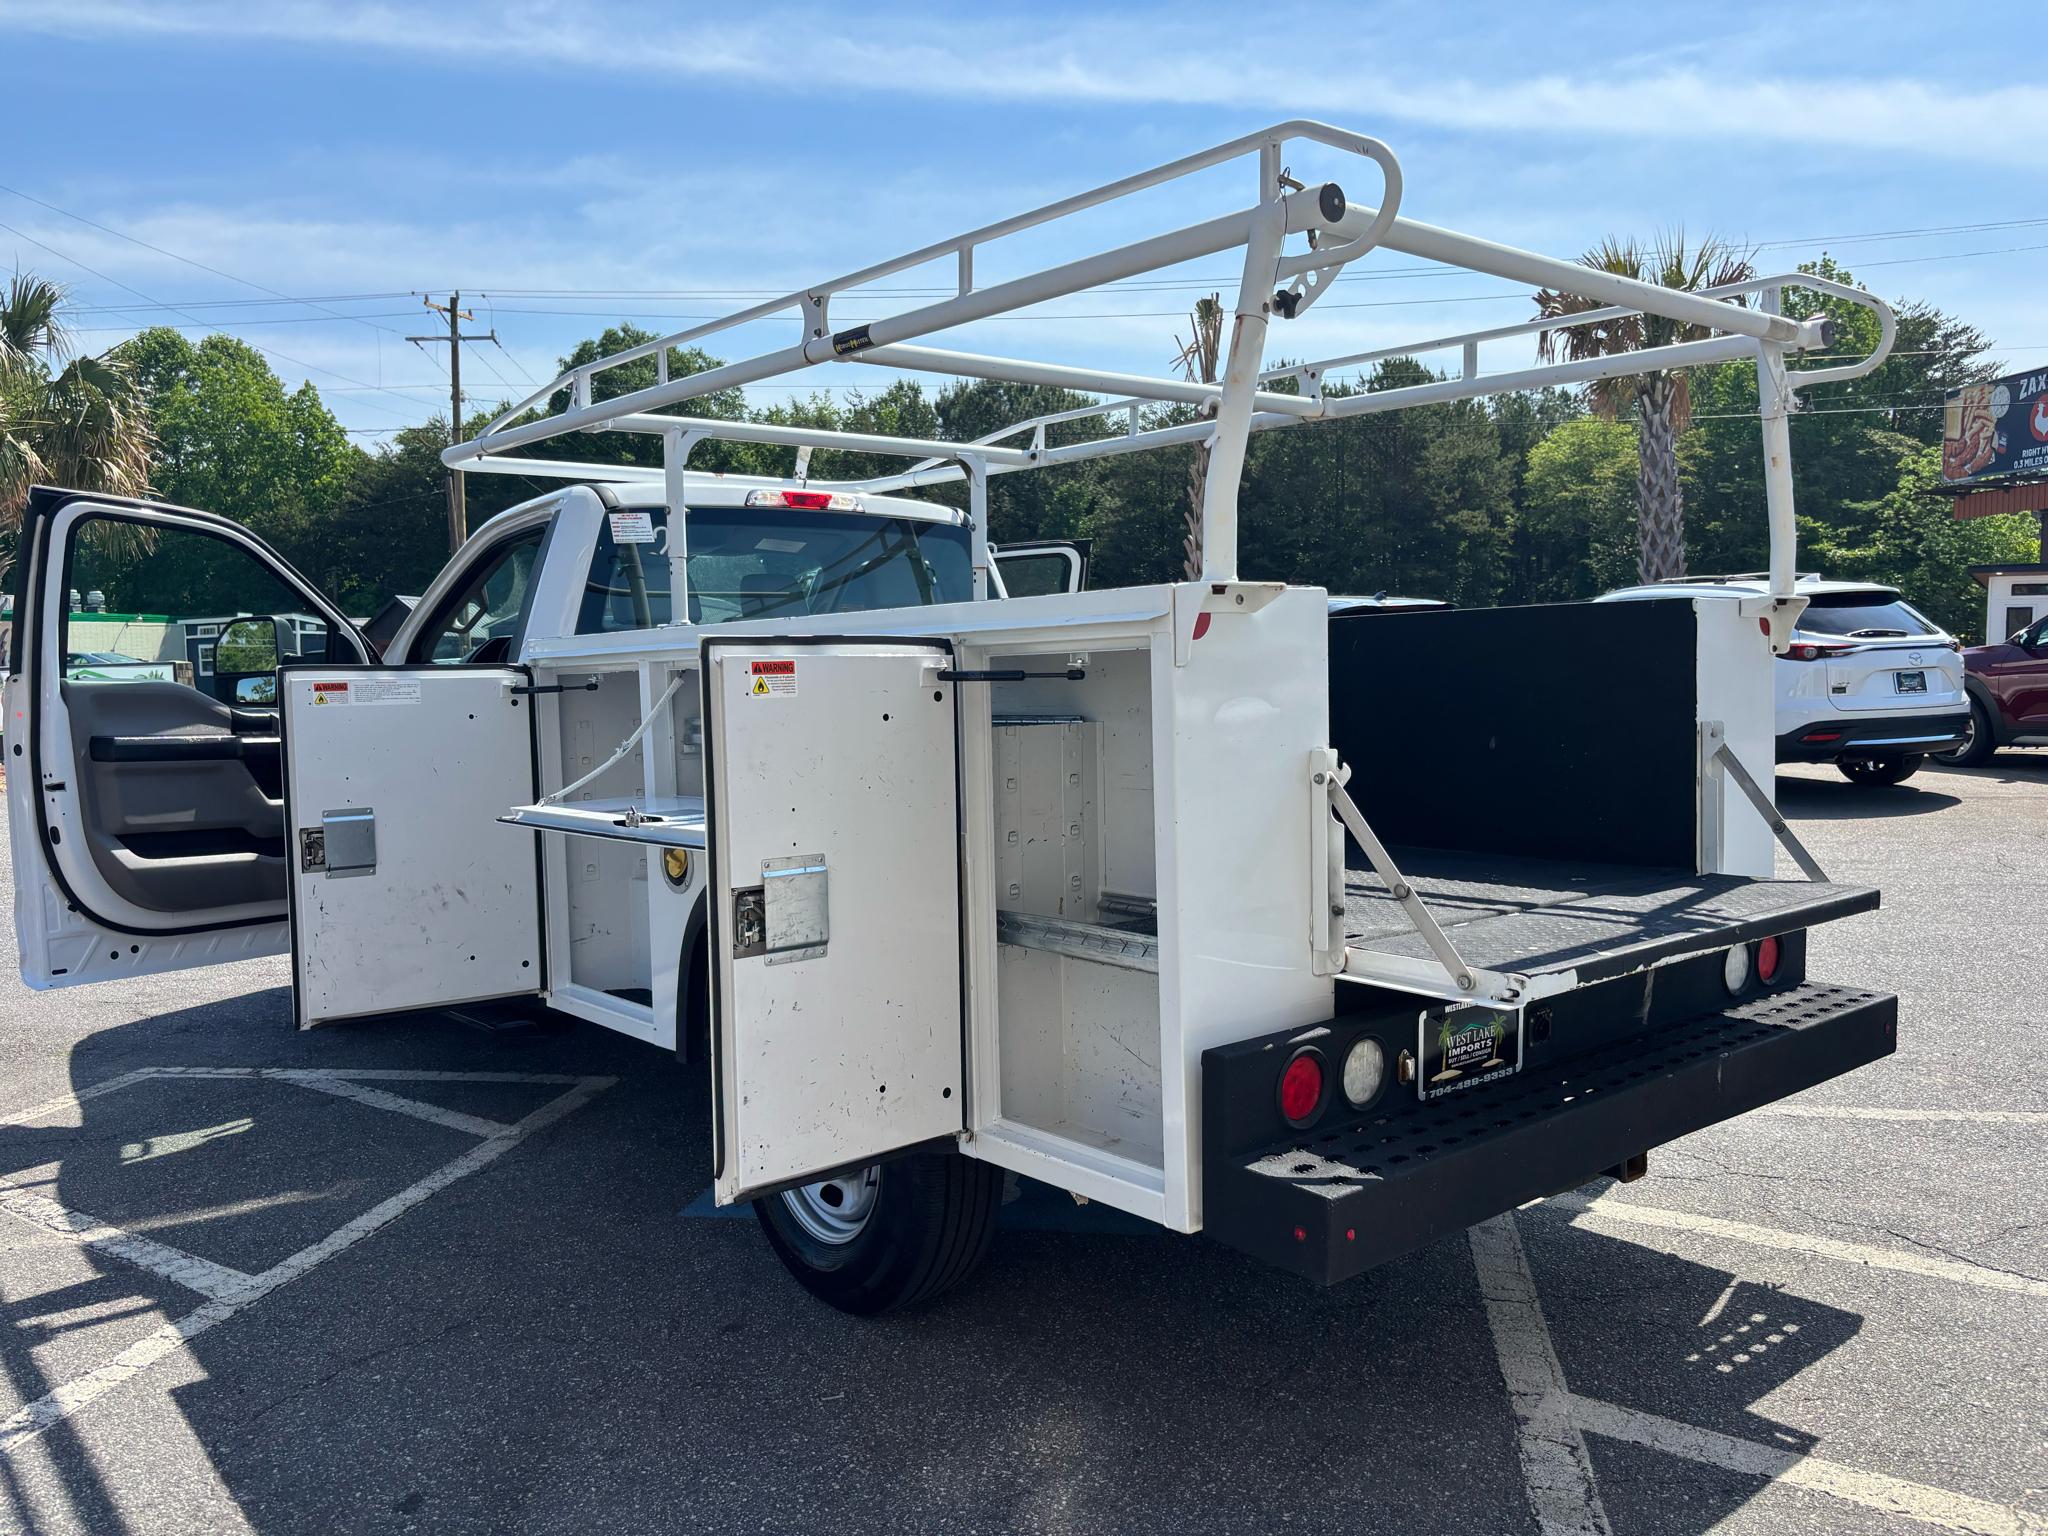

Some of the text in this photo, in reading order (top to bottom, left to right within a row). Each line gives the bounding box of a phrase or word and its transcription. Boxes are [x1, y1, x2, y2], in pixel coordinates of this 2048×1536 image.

[2022, 447, 2041, 458] RIGHT
[2014, 460, 2023, 470] 0.3
[2024, 457, 2043, 468] MILES
[762, 663, 794, 673] WARNING
[322, 683, 348, 691] WARNING
[1447, 1025, 1496, 1049] WEST LAKE
[1449, 1038, 1492, 1057] IMPORTS
